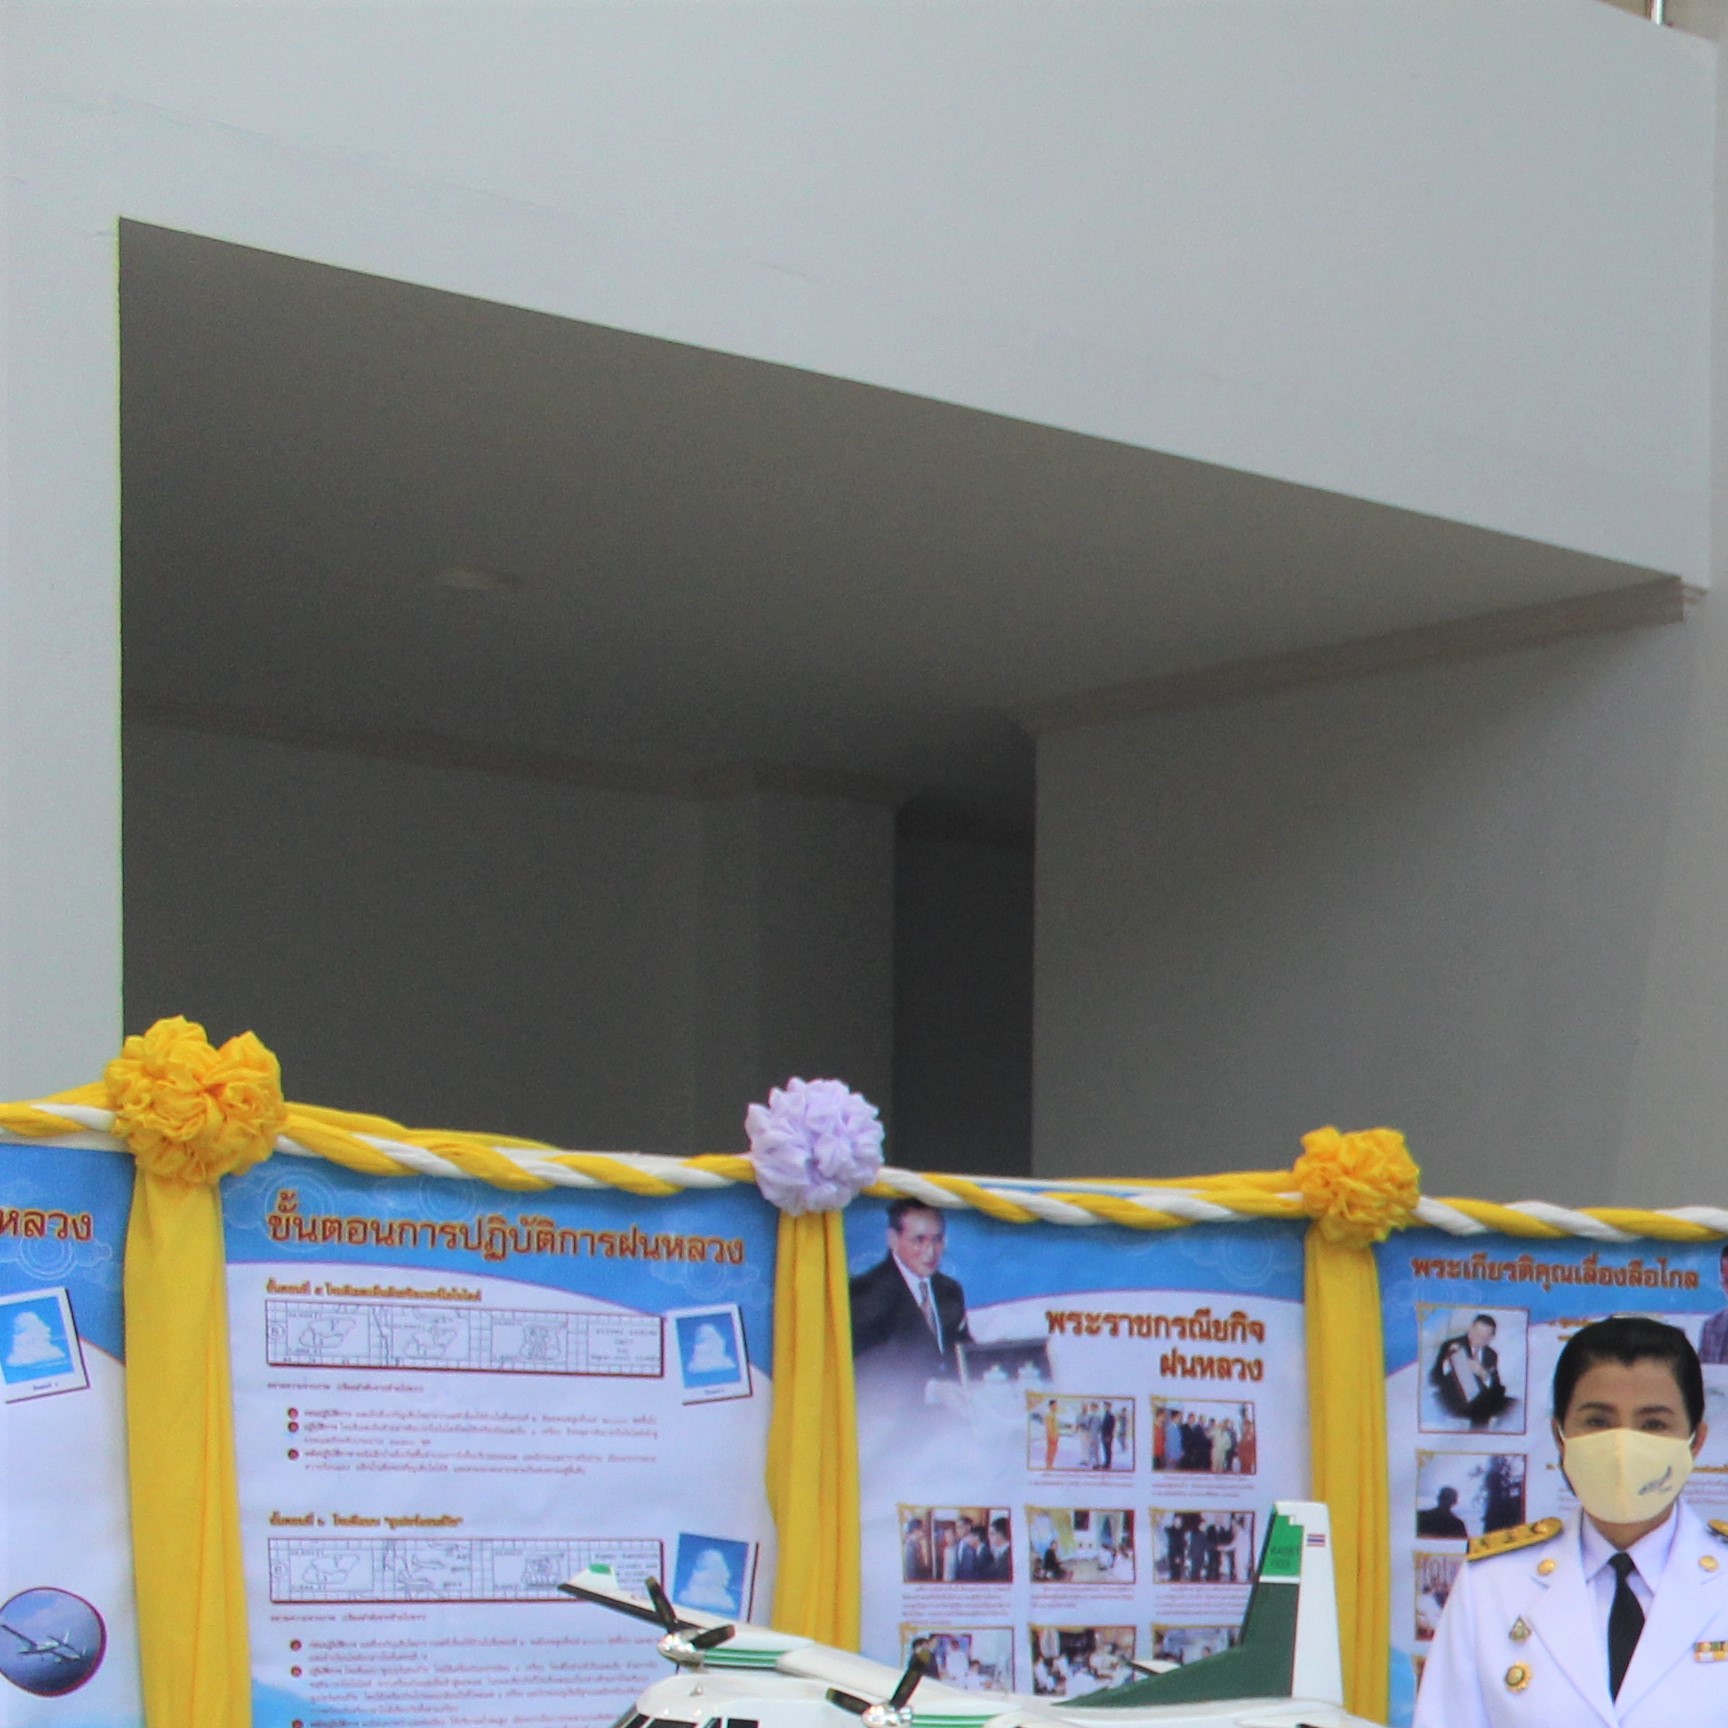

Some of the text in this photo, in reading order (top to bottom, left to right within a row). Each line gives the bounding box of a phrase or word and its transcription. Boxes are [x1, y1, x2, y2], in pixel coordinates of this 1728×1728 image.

[265, 1192, 745, 1266] ขั้นตอนการปฏิบัติการฝนหลวง
[1411, 1252, 1699, 1291] พระเกียรติคุณเลื่องลือไกล
[1045, 1308, 1266, 1343] พระราชกรณียกิจ
[1159, 1347, 1264, 1381] ฝนหลวง
